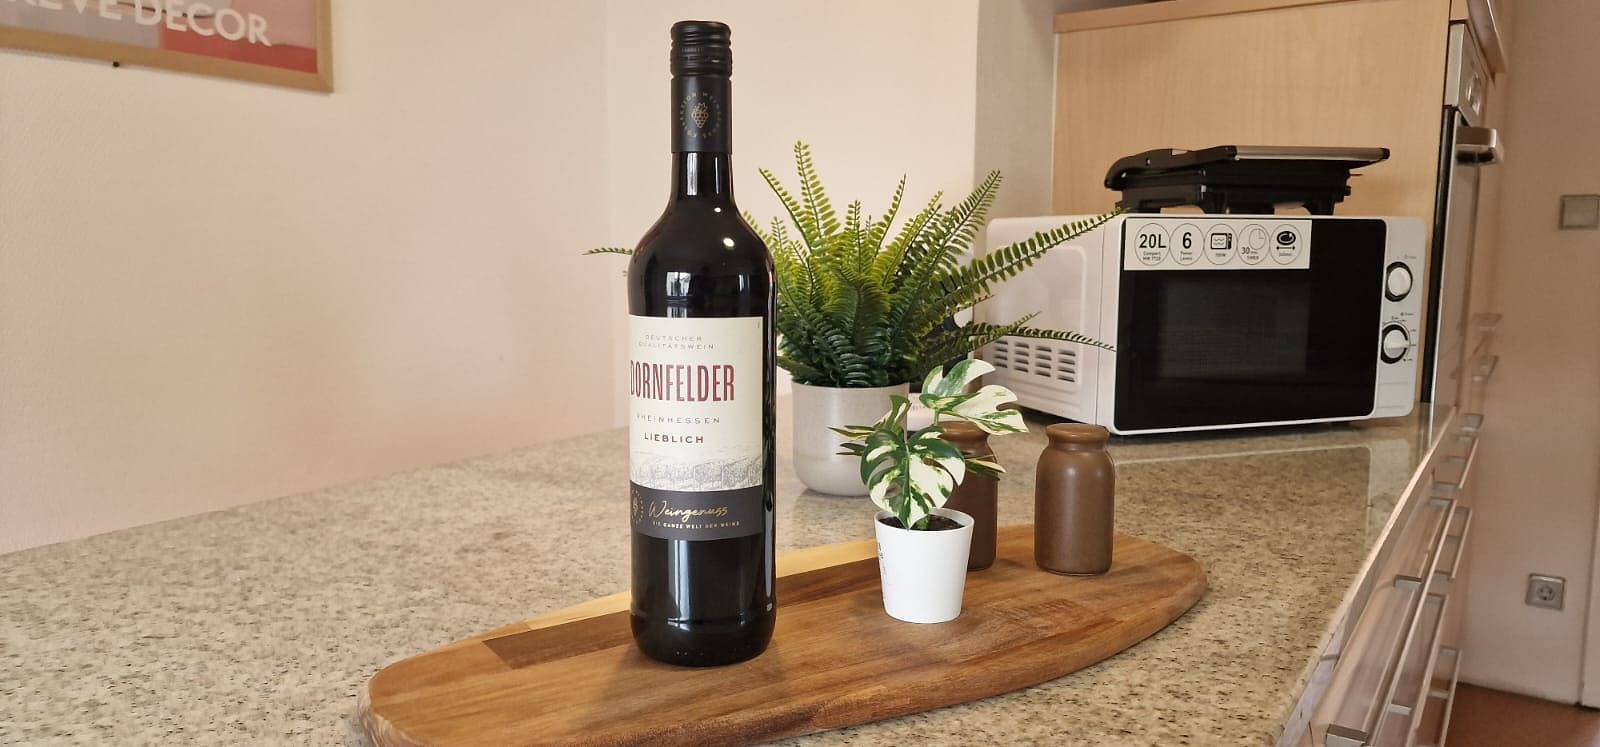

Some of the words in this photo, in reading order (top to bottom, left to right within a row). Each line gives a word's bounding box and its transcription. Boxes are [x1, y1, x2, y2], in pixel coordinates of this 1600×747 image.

[1139, 233, 1167, 249] 20L
[1182, 232, 1192, 249] 6
[1241, 246, 1250, 254] 30
[630, 359, 735, 402] DORNFELDER
[644, 432, 704, 444] LIEBLICH
[648, 500, 728, 522] Weingenuss
